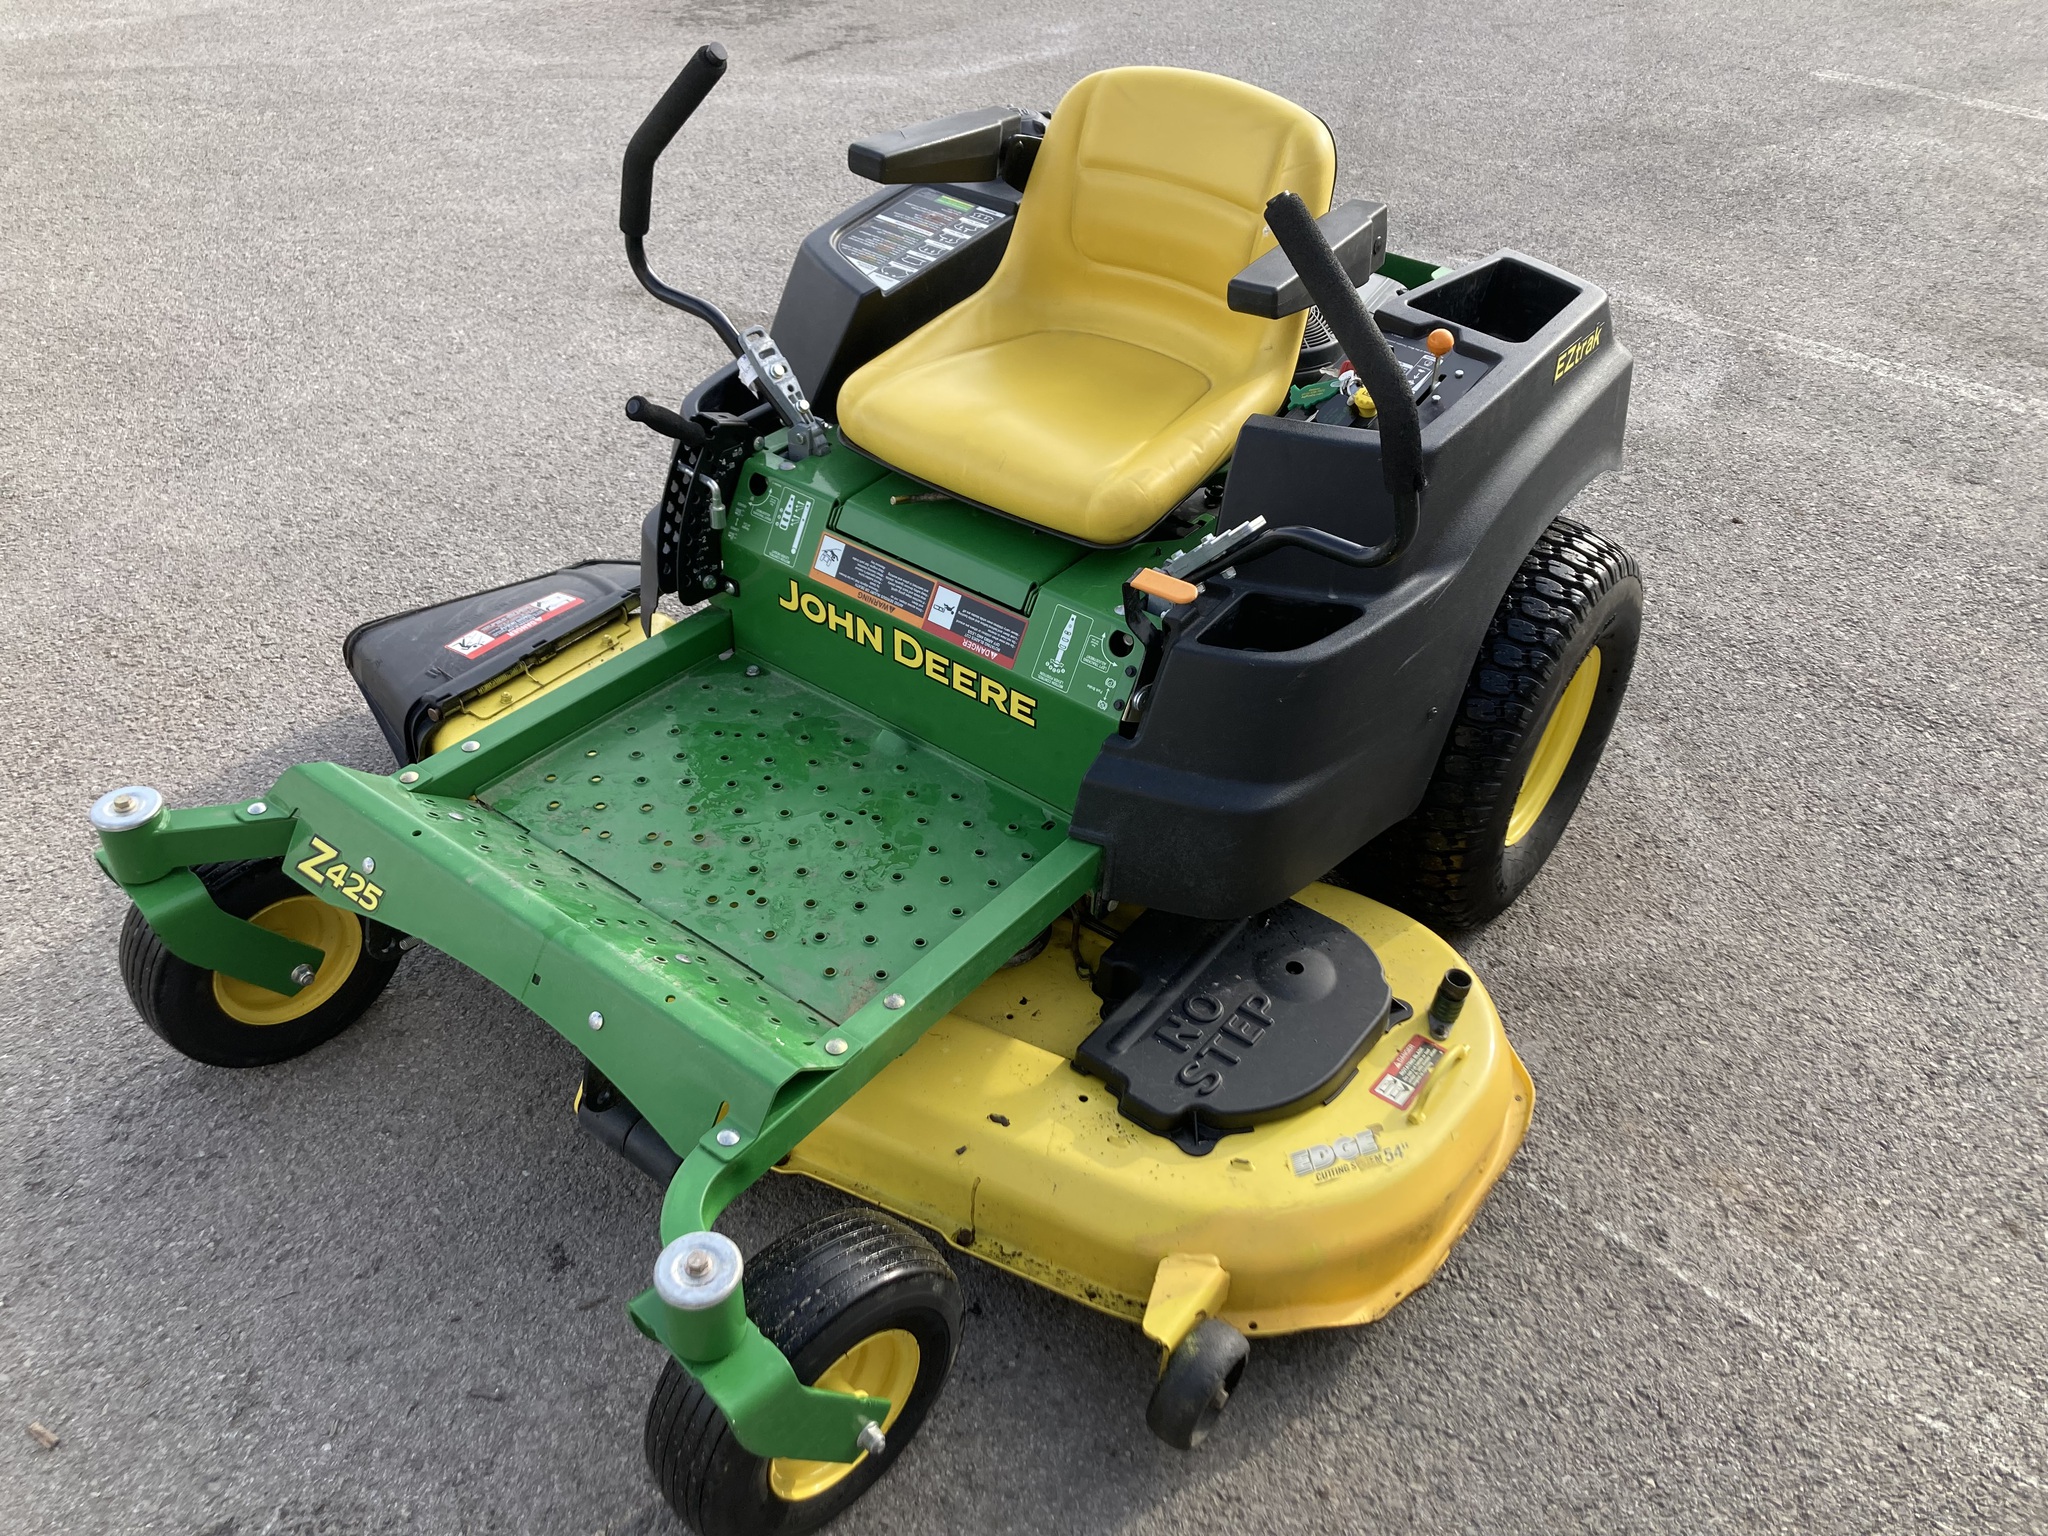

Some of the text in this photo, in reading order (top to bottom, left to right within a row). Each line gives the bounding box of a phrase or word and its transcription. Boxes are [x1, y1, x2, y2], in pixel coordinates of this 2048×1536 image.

[1554, 326, 1602, 381] EZtrak
[856, 590, 890, 611] WARNING
[778, 578, 1037, 728] JOHN DEERE
[961, 638, 990, 657] DANGER
[970, 635, 984, 644] BLADES
[984, 641, 1000, 652] ROTATING
[297, 834, 387, 912] Z425
[1155, 993, 1224, 1052] NO
[1176, 993, 1276, 1096] STEP
[1395, 1043, 1415, 1063] DANGER
[1290, 1129, 1380, 1178] EDGE
[1315, 1142, 1409, 1182] CUTTING SEM 54"
